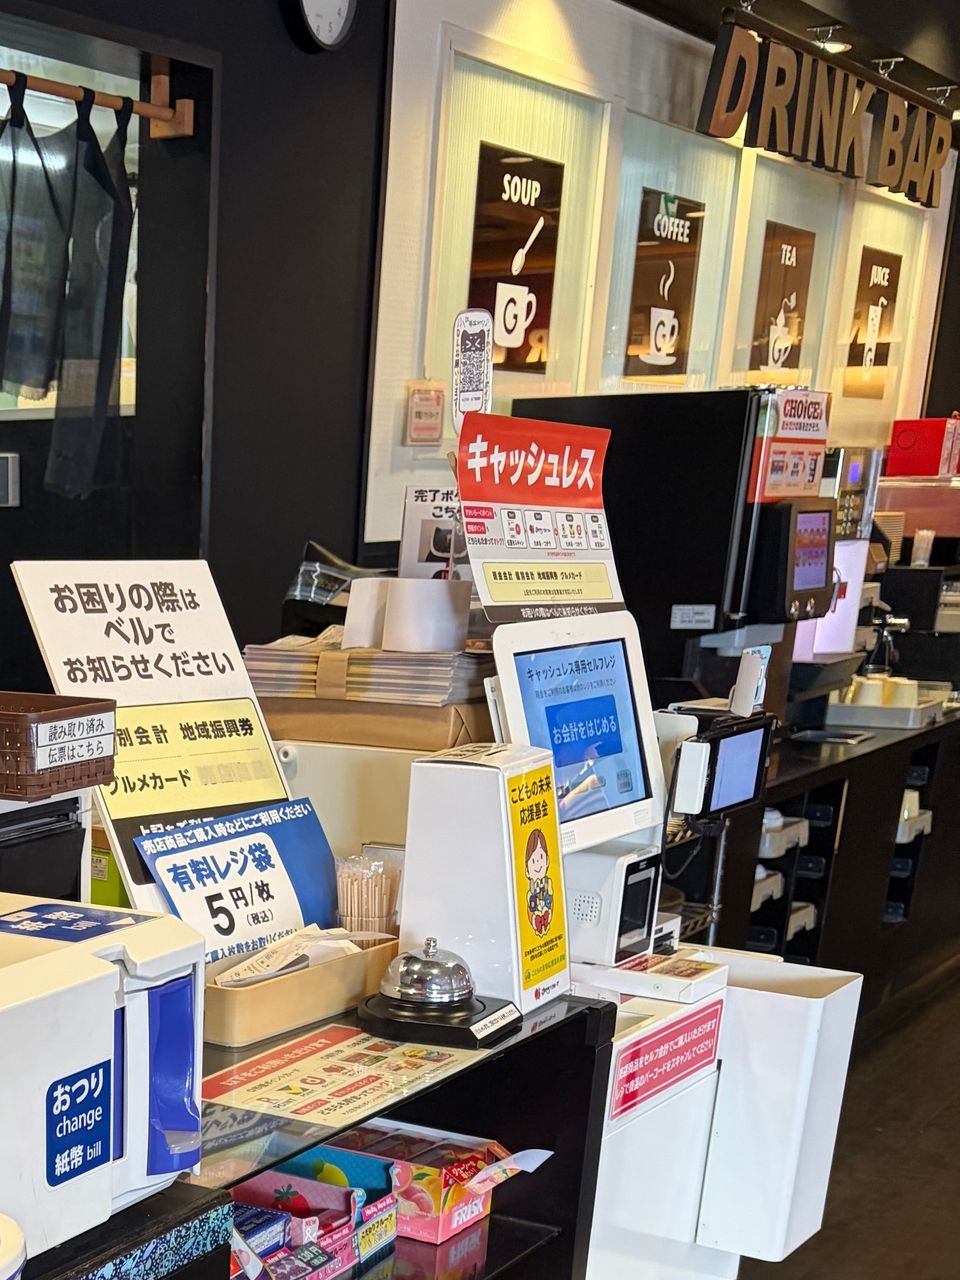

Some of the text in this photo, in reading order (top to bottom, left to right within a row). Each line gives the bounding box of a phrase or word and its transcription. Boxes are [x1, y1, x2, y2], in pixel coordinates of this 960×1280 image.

[705, 23, 953, 208] DRINK BAR
[502, 173, 541, 207] SOUP
[653, 213, 690, 243] COFFEE
[781, 244, 797, 267] TEA
[869, 264, 890, 287] JUICE
[467, 433, 596, 491] キャッシュレス
[49, 580, 200, 615] お困りの際は
[104, 616, 176, 647] ベルで
[63, 651, 235, 684] お知らせください
[527, 655, 617, 681] キャッシュレス専用セルフレジ
[47, 718, 105, 743] 読み取り済み
[179, 717, 255, 742] 地域振興券
[552, 715, 617, 745] お会計をはじめる
[47, 740, 105, 765] 伝票はこちら
[510, 776, 552, 803] こどもの未来
[519, 800, 549, 826] 応援基金
[141, 803, 312, 855] 売店商品ご購入時などにご利用ください
[166, 842, 275, 892] 有料レジ袋
[246, 908, 274, 927] (税込)
[52, 1067, 104, 1116] おつり
[56, 1105, 103, 1139] change
[55, 1141, 102, 1177] 紙幣 bill
